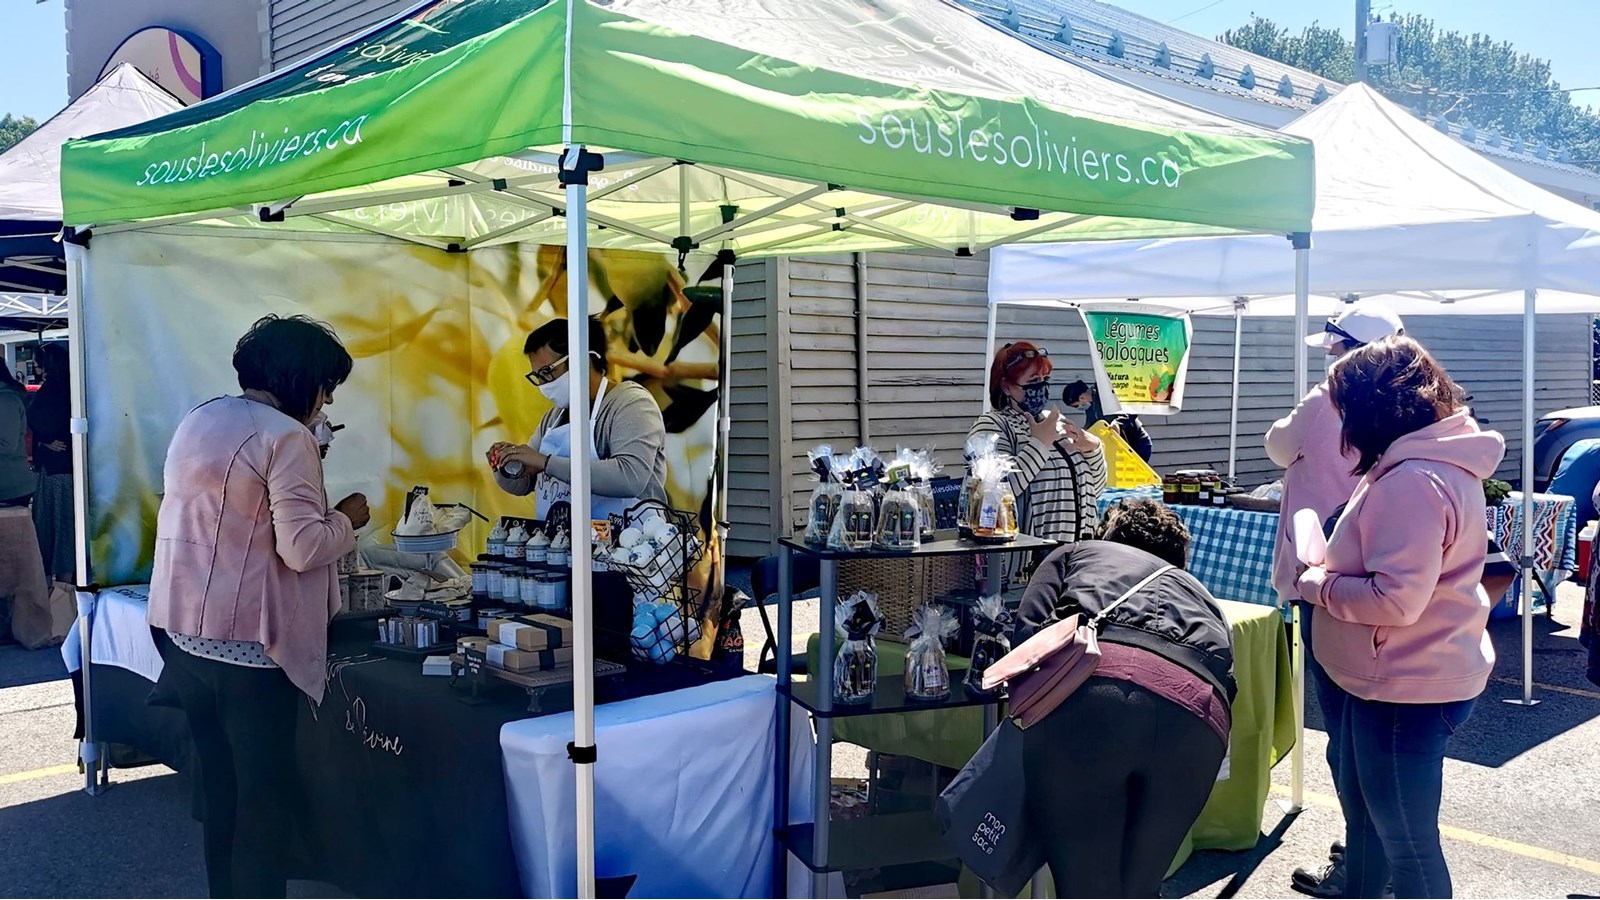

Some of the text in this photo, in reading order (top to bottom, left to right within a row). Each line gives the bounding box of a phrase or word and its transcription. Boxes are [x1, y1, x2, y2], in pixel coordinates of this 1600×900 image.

[136, 113, 370, 187] souslesoliviers.ca
[857, 110, 1181, 189] souslesoliviers.ca
[1104, 317, 1160, 343] Légumes
[1096, 341, 1169, 367] Biologques
[977, 822, 1000, 846] petit
[984, 812, 1006, 835] mon
[972, 832, 989, 851] sac
